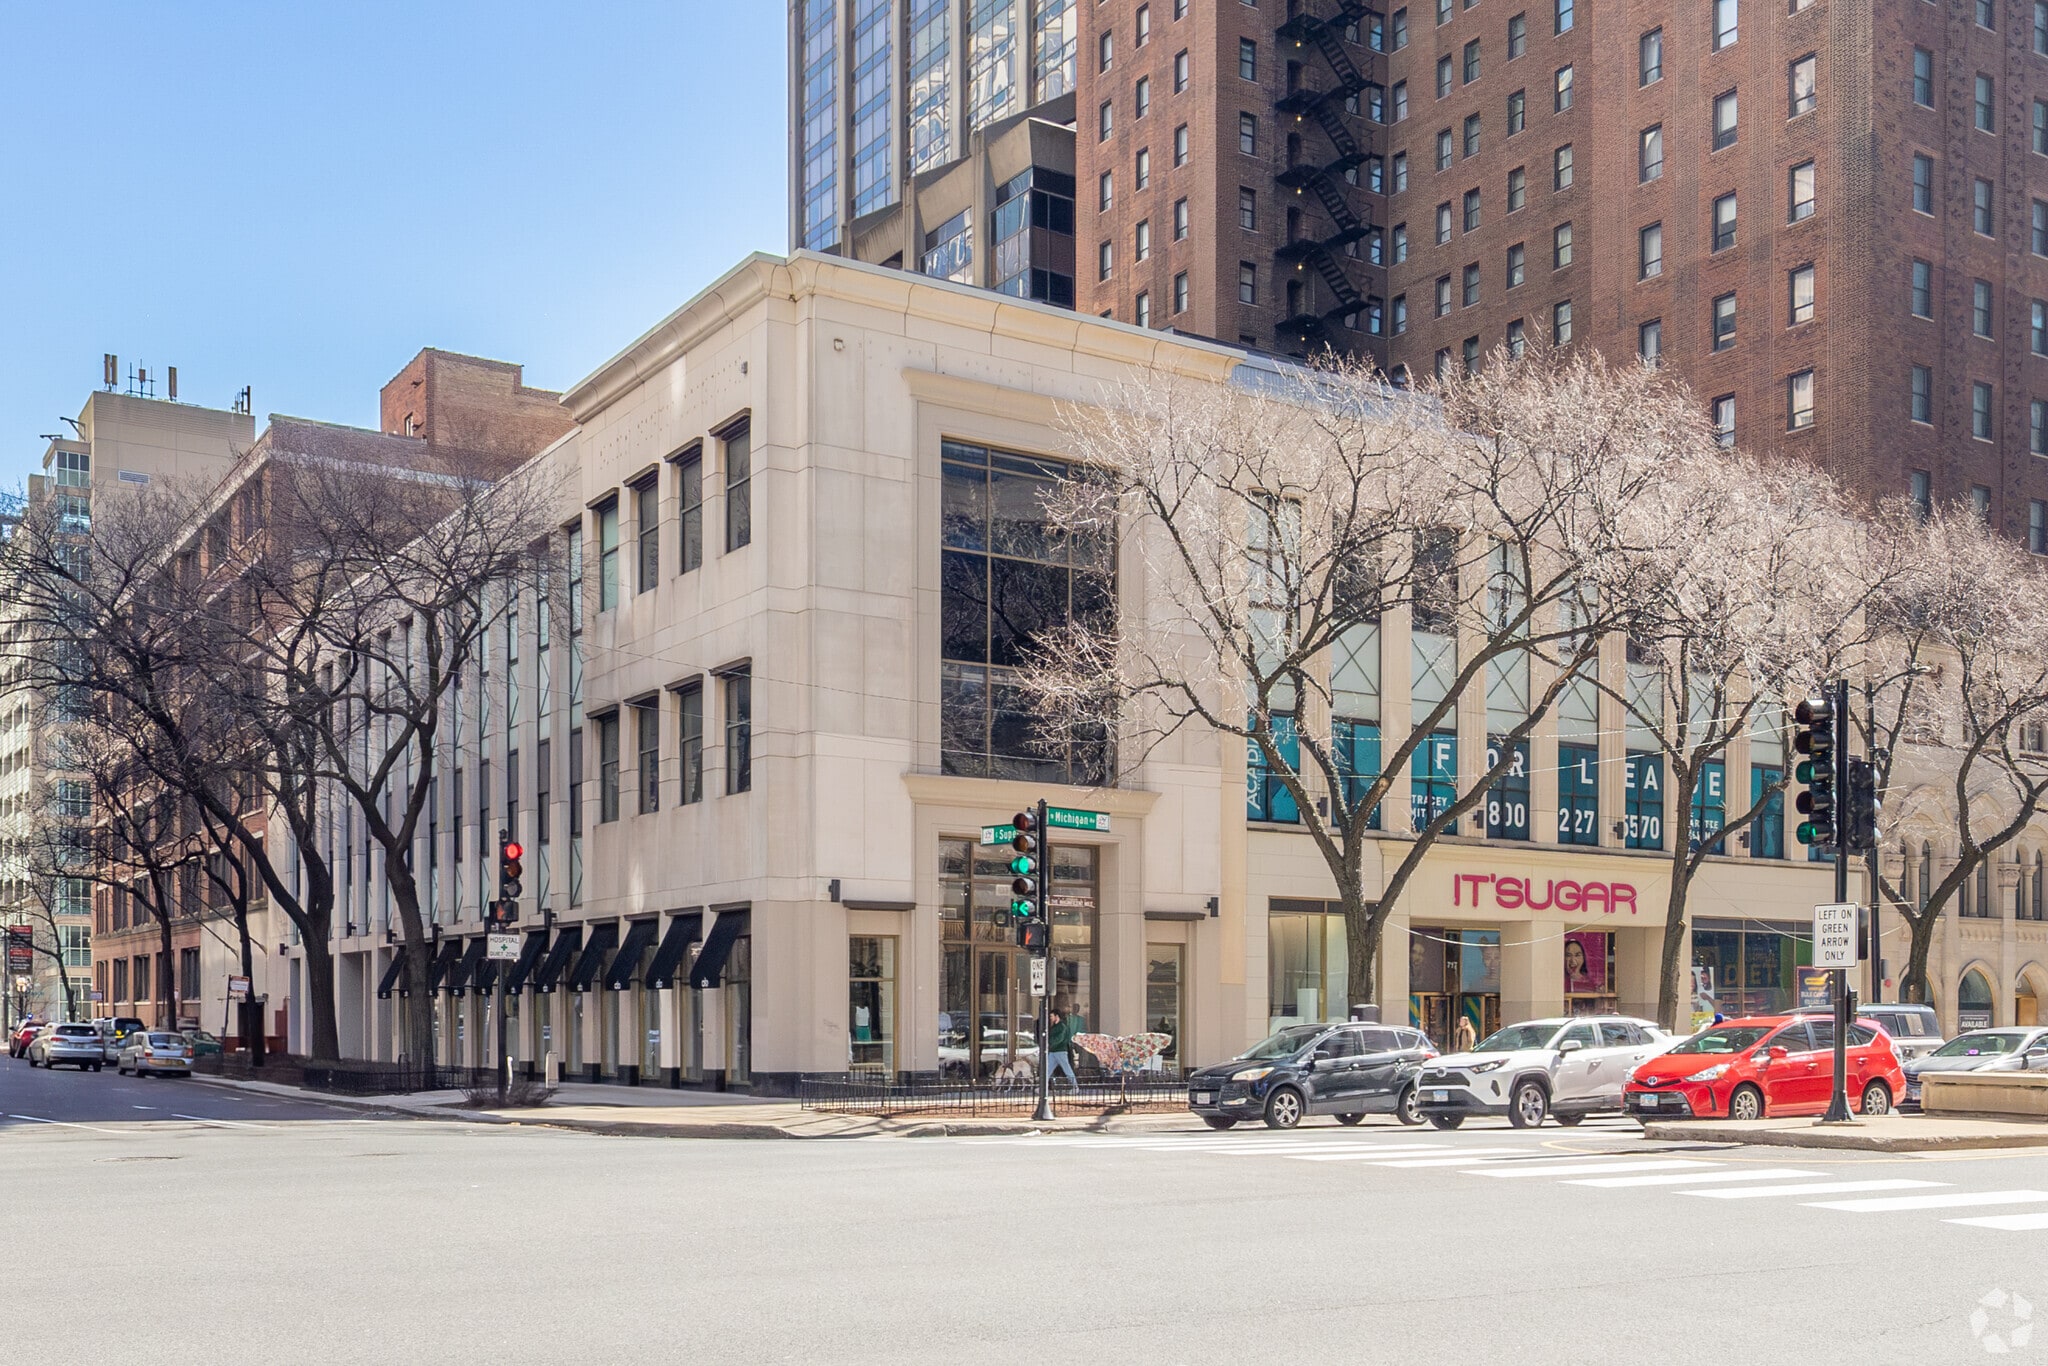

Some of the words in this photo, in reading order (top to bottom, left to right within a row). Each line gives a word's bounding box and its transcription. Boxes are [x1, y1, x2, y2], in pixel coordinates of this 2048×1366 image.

[1437, 743, 1525, 778] FOR
[1581, 758, 1722, 797] LEAE
[1412, 794, 1448, 806] TRACEY
[1055, 811, 1089, 827] Michigan
[1489, 801, 1525, 828] 800
[1559, 808, 1595, 834] 227
[999, 829, 1018, 842] Supe
[1453, 873, 1638, 915] IT'SUGAR
[1818, 909, 1837, 920] LEFT
[1841, 908, 1852, 919] ON
[1822, 923, 1848, 934] GREEN
[489, 936, 519, 944] HOSPITAL
[1821, 936, 1850, 947] ARROW
[1824, 950, 1845, 961] ONLY
[1032, 961, 1044, 970] ONE
[1032, 971, 1044, 980] WAY
[1960, 1020, 1987, 1028] AVAILABLE
